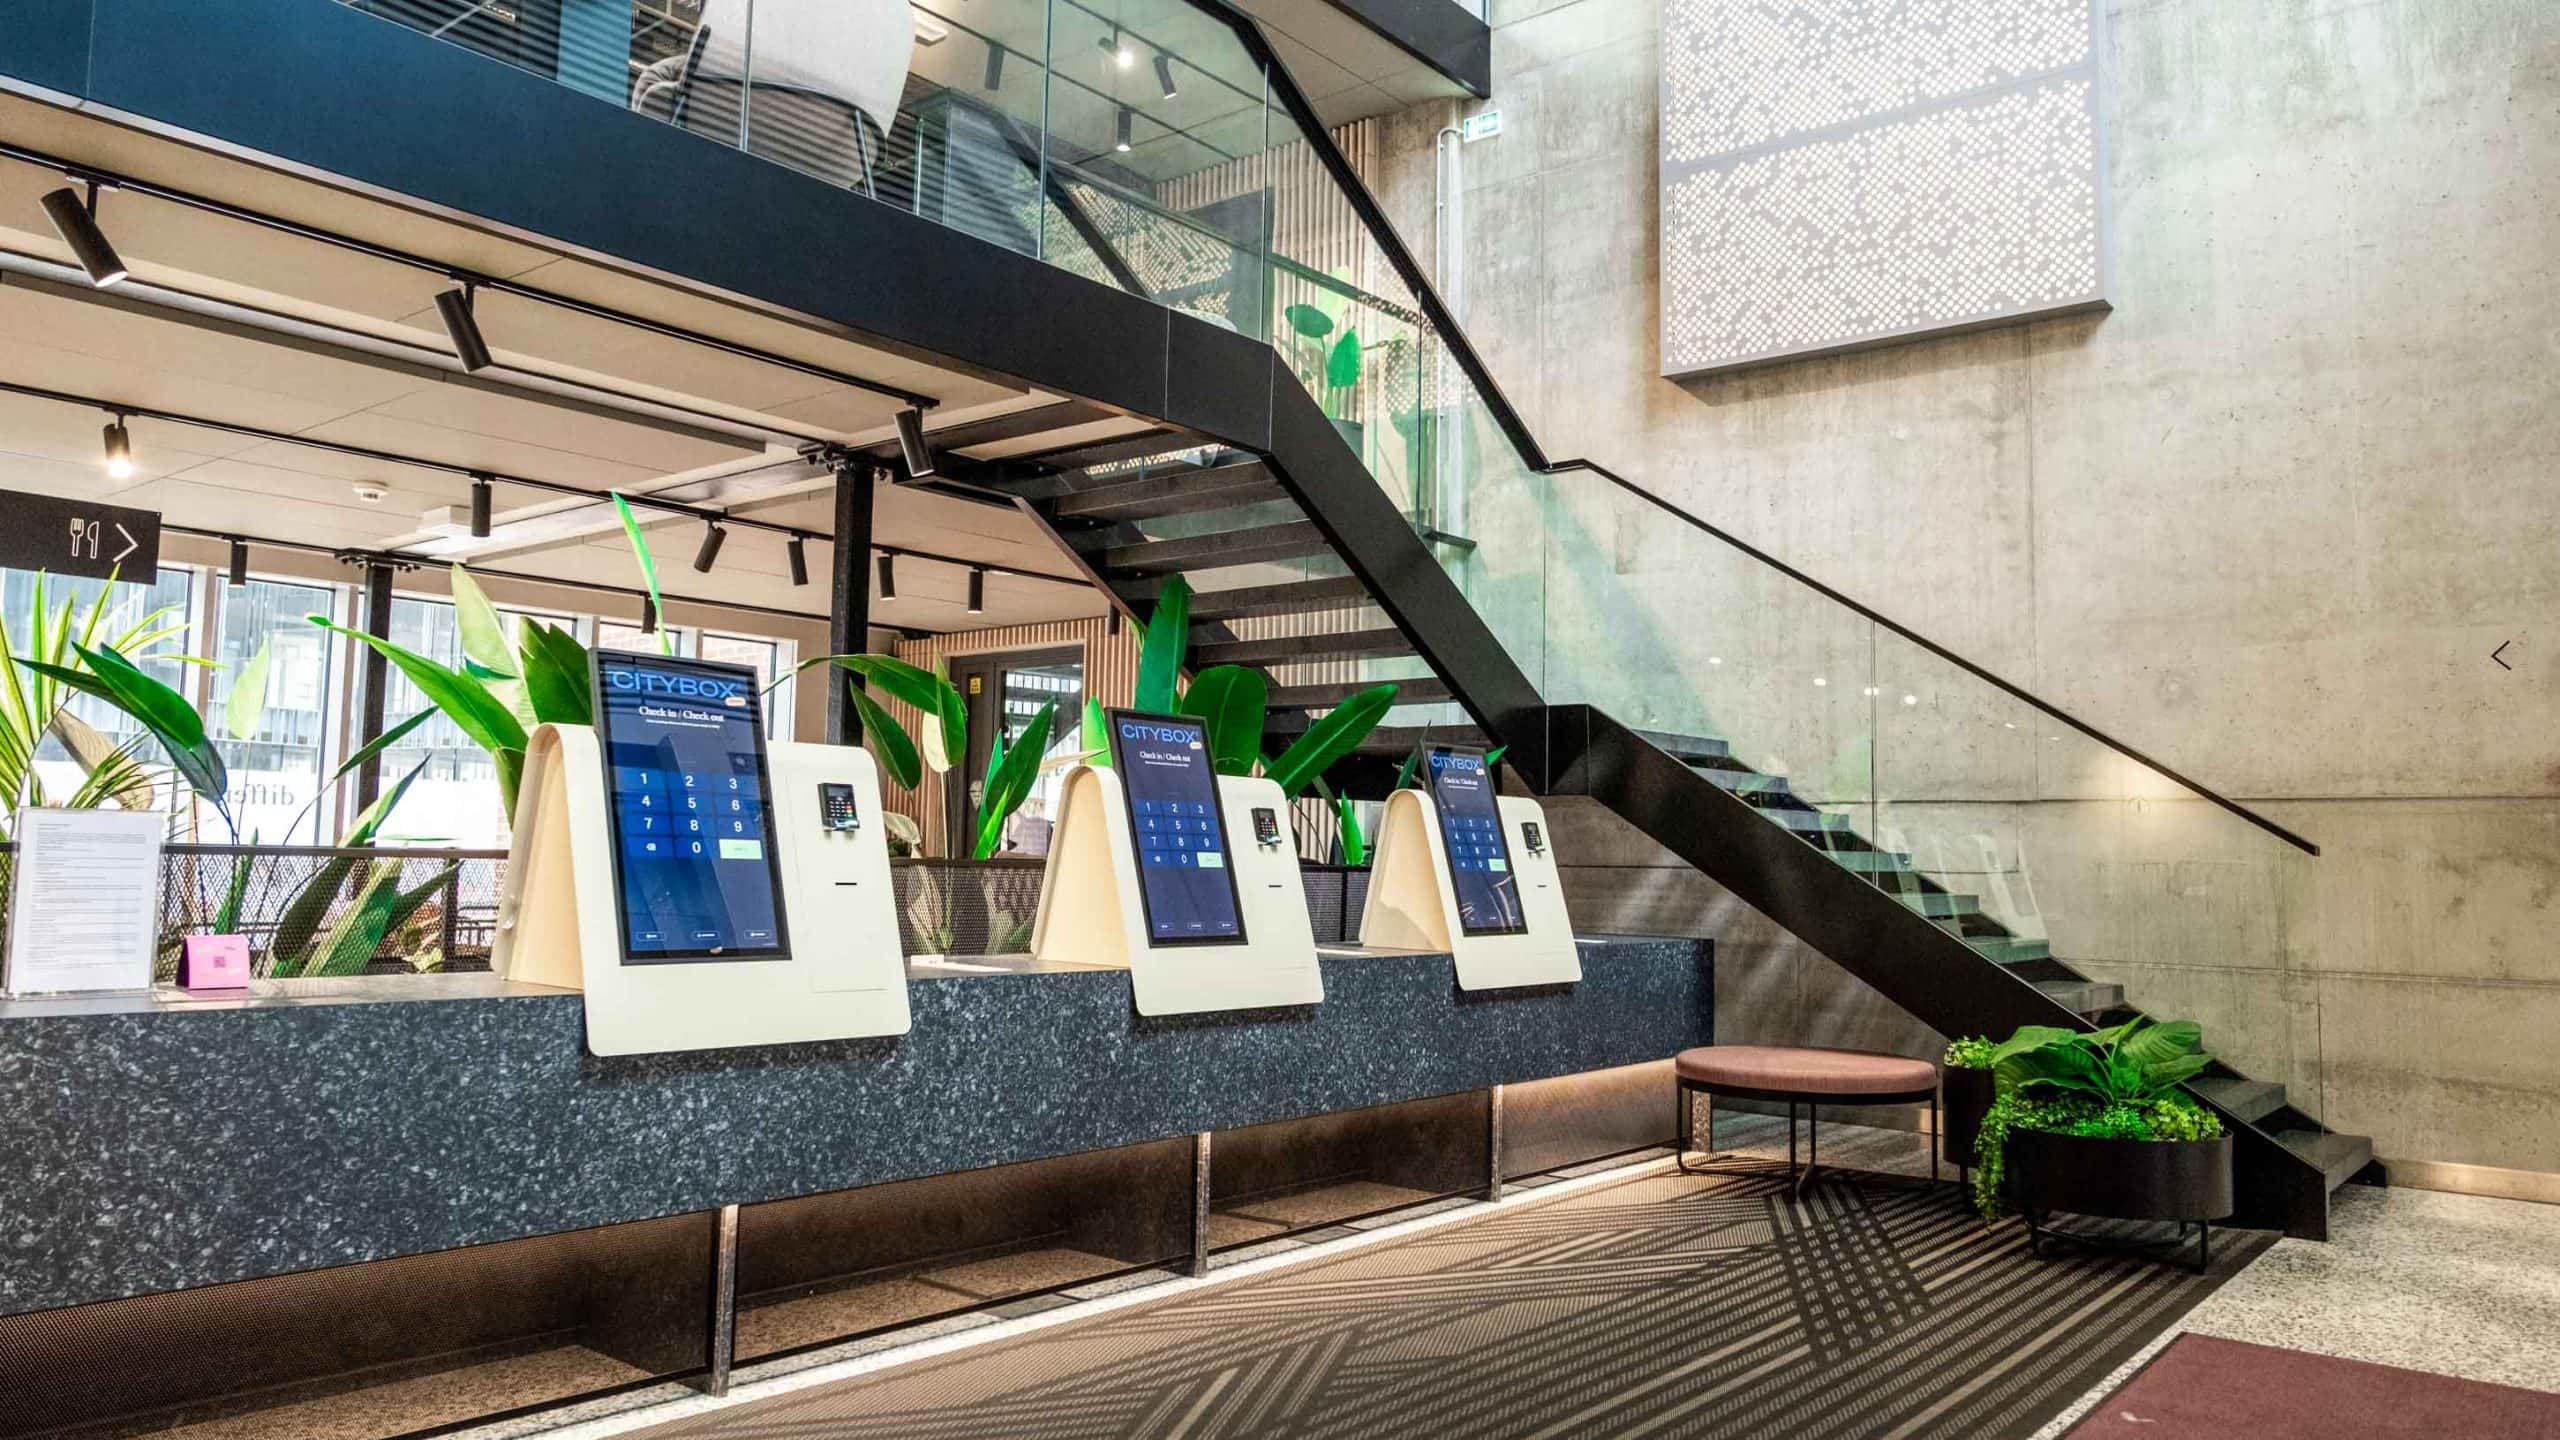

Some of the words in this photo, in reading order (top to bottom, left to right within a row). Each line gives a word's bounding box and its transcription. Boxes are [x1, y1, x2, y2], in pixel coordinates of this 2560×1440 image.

[612, 671, 736, 698] CITYBOX
[639, 706, 666, 717] Check
[683, 710, 709, 720] Check
[1122, 724, 1195, 743] CITYBOX
[1431, 756, 1480, 770] CITYBOX
[640, 773, 647, 784] 1
[685, 775, 695, 787] 2
[729, 778, 738, 789] 3
[642, 795, 651, 807] 4
[687, 797, 697, 809] 5
[731, 800, 740, 811] 6
[1146, 802, 1151, 812] 1
[1171, 803, 1179, 813] 2
[644, 817, 653, 830] 7
[690, 820, 699, 831] 8
[734, 821, 743, 832] 9
[1148, 819, 1154, 829] 4
[1175, 820, 1182, 830] 5
[692, 841, 701, 853] 0
[1150, 836, 1158, 847] 7
[1181, 854, 1188, 864] 0
